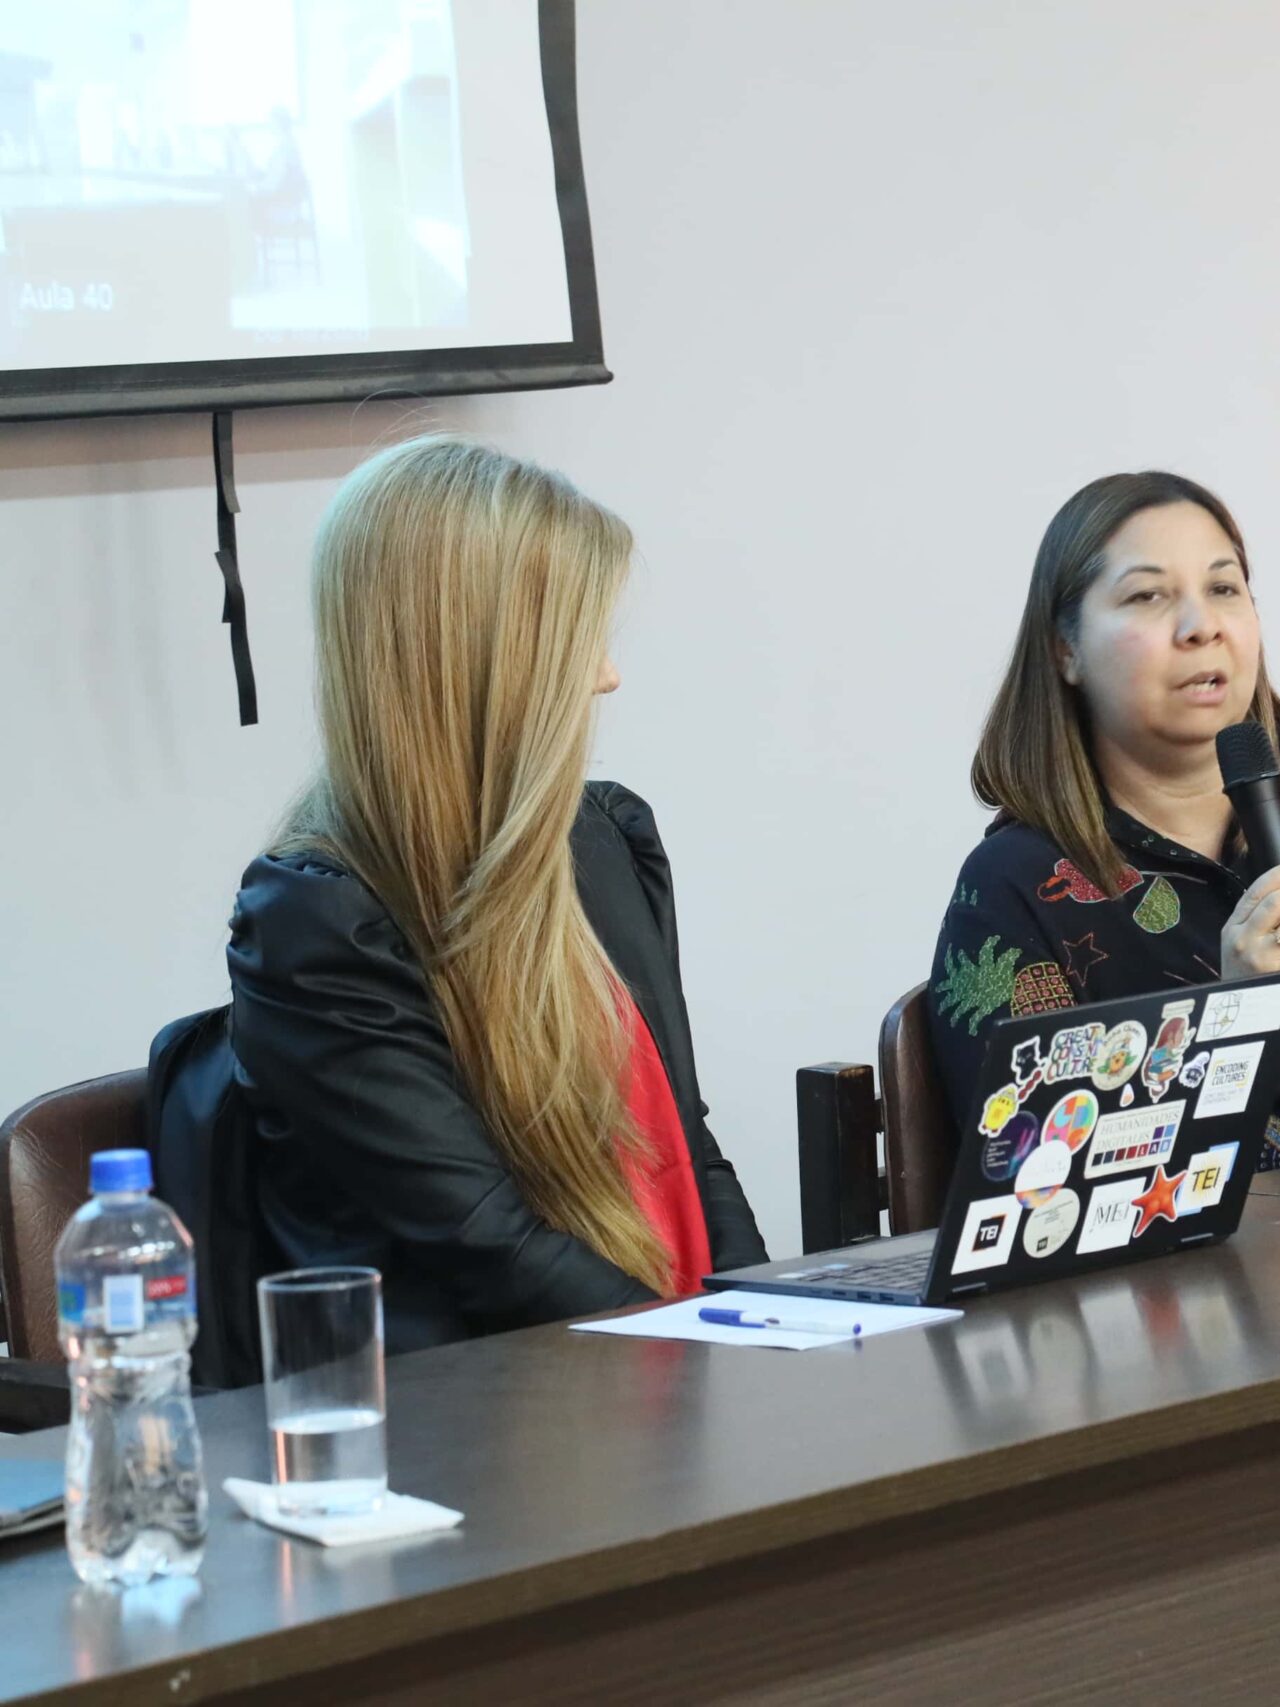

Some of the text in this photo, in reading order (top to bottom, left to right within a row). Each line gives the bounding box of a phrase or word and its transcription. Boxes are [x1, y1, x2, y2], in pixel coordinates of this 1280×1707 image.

[20, 281, 113, 311] Aula 40
[1101, 1110, 1180, 1135] HUMANIDADES
[1192, 1167, 1221, 1192] TEI
[980, 1225, 999, 1241] TEI
